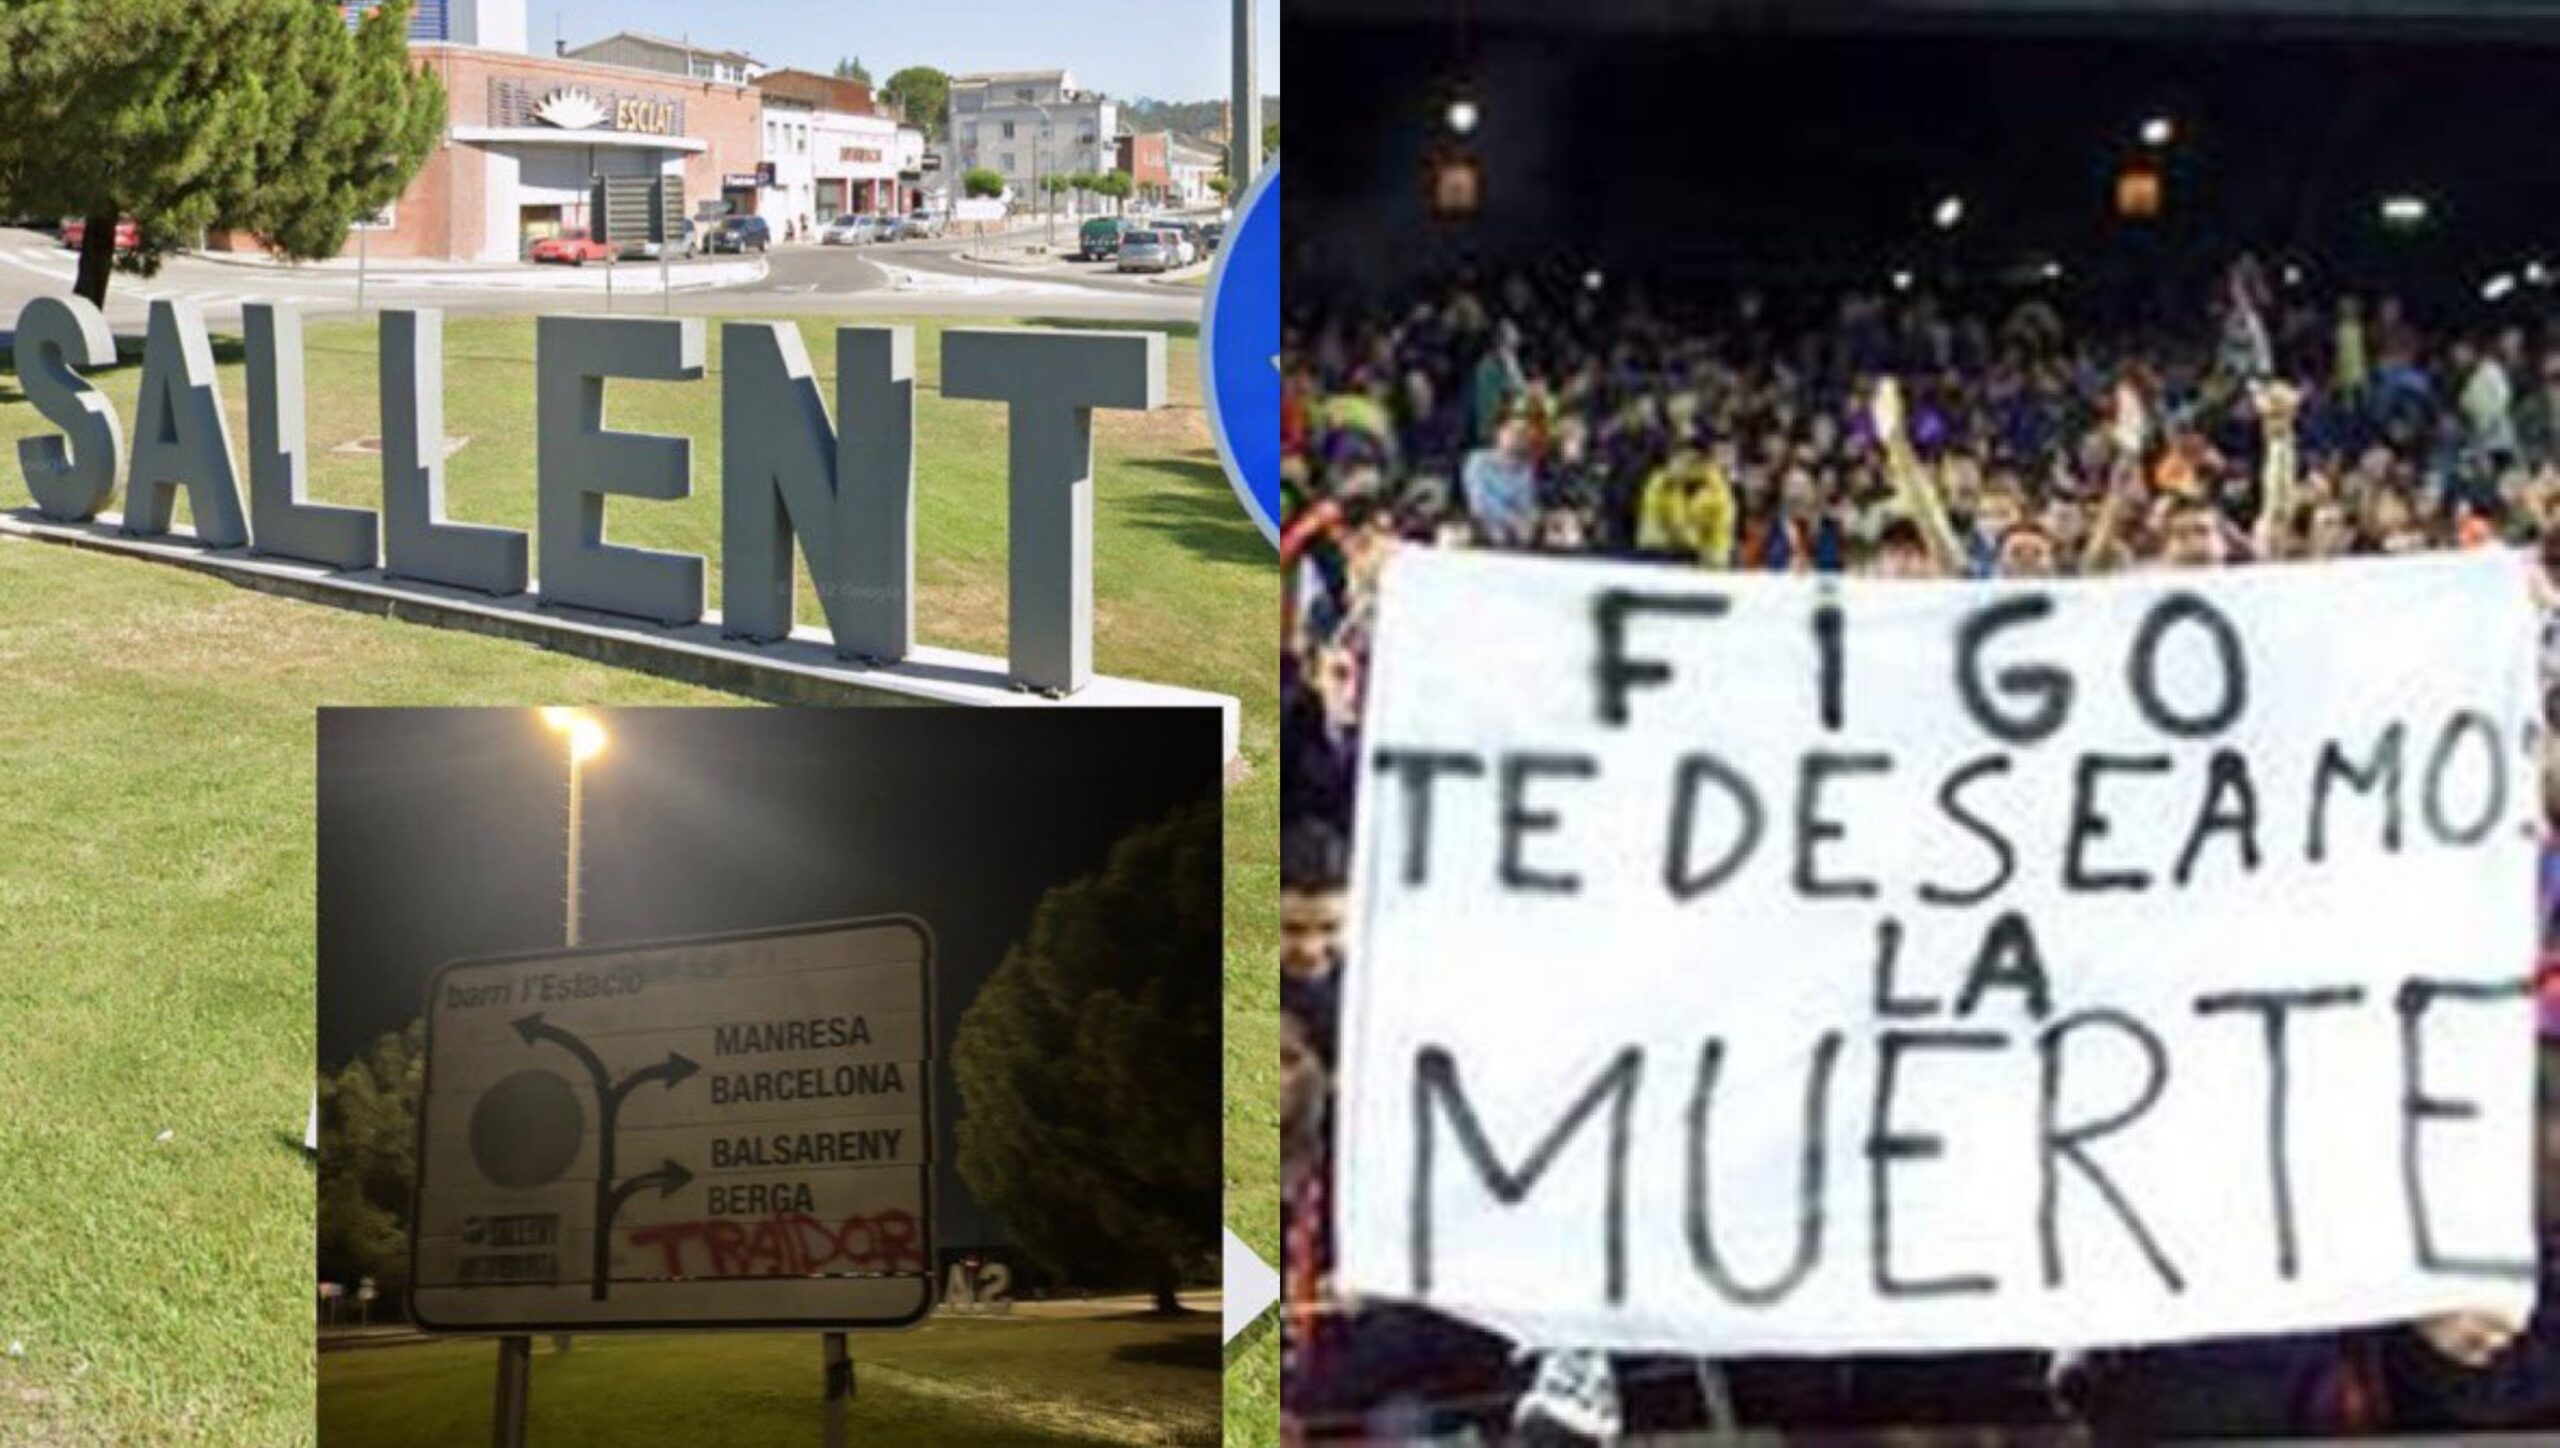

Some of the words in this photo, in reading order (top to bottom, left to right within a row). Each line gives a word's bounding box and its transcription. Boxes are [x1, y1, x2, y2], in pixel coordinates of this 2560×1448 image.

[14, 295, 1167, 698] SALLENT
[1372, 750, 1600, 894] TE
[1872, 912, 2051, 1018] LA
[714, 1015, 871, 1057] MANRESA
[709, 1061, 905, 1105] BARCELONA
[710, 1127, 904, 1169] BALSARENY
[1408, 976, 2538, 1307] MUERTE
[707, 1182, 815, 1216] BERGA
